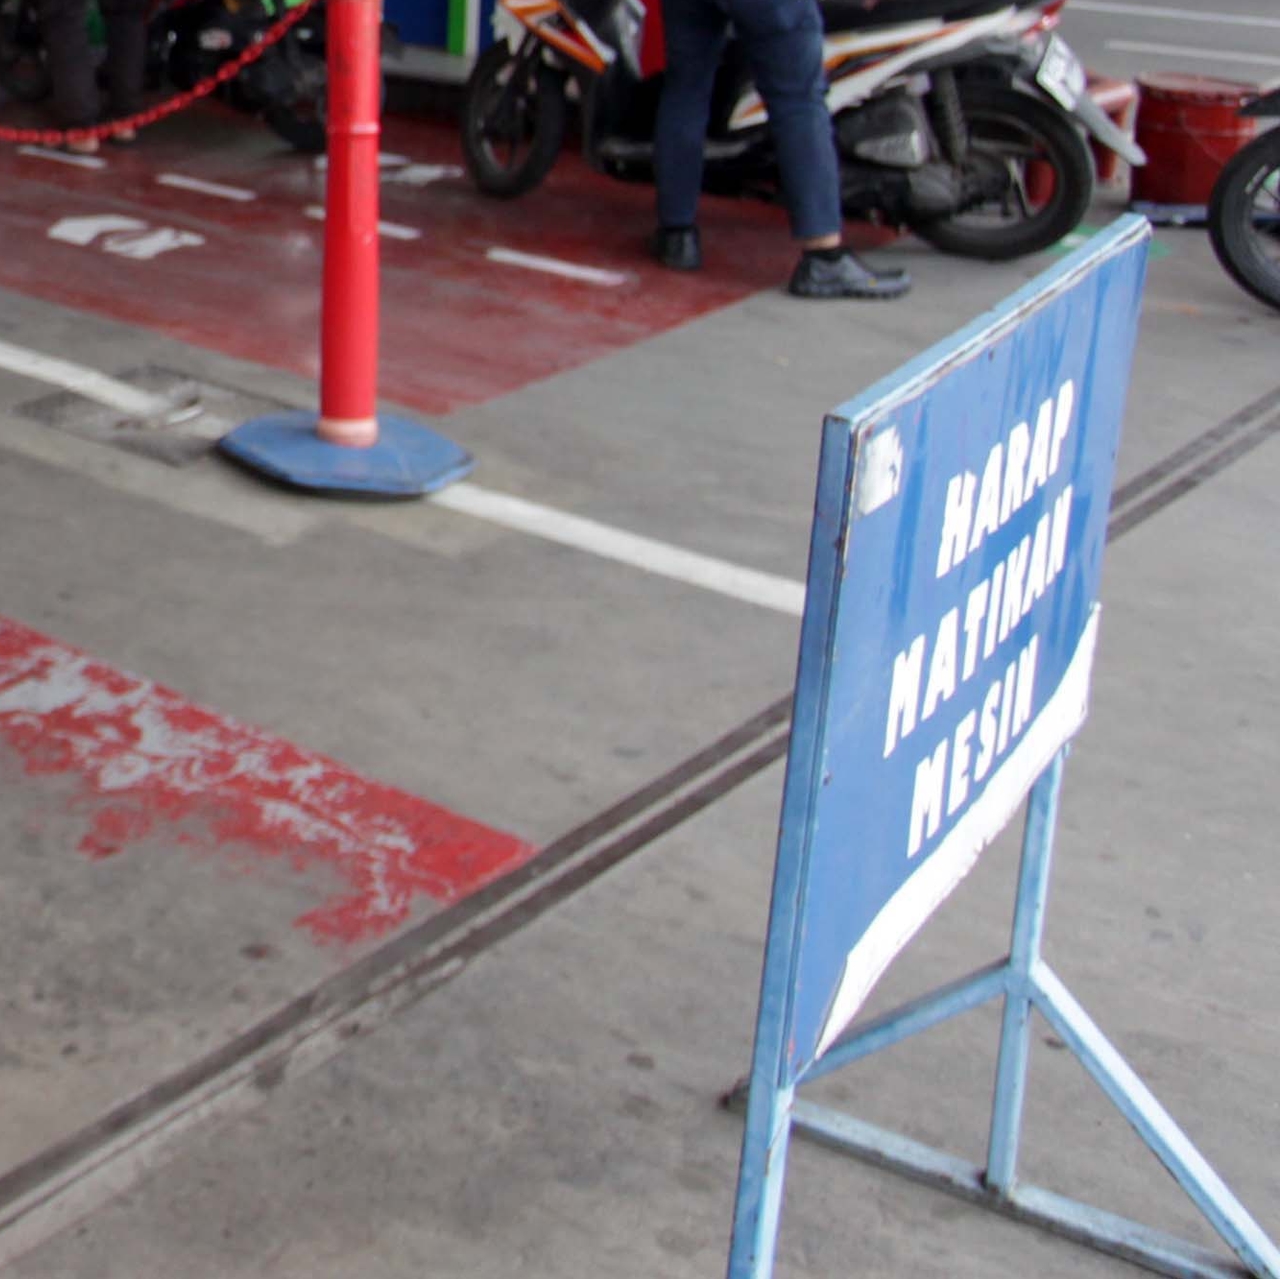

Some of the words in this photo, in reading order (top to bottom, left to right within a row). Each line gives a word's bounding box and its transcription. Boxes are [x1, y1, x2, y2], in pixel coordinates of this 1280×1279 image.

[936, 378, 1074, 579] HARAP
[883, 484, 1074, 759] MATIKAN
[906, 633, 1039, 860] MESIN
